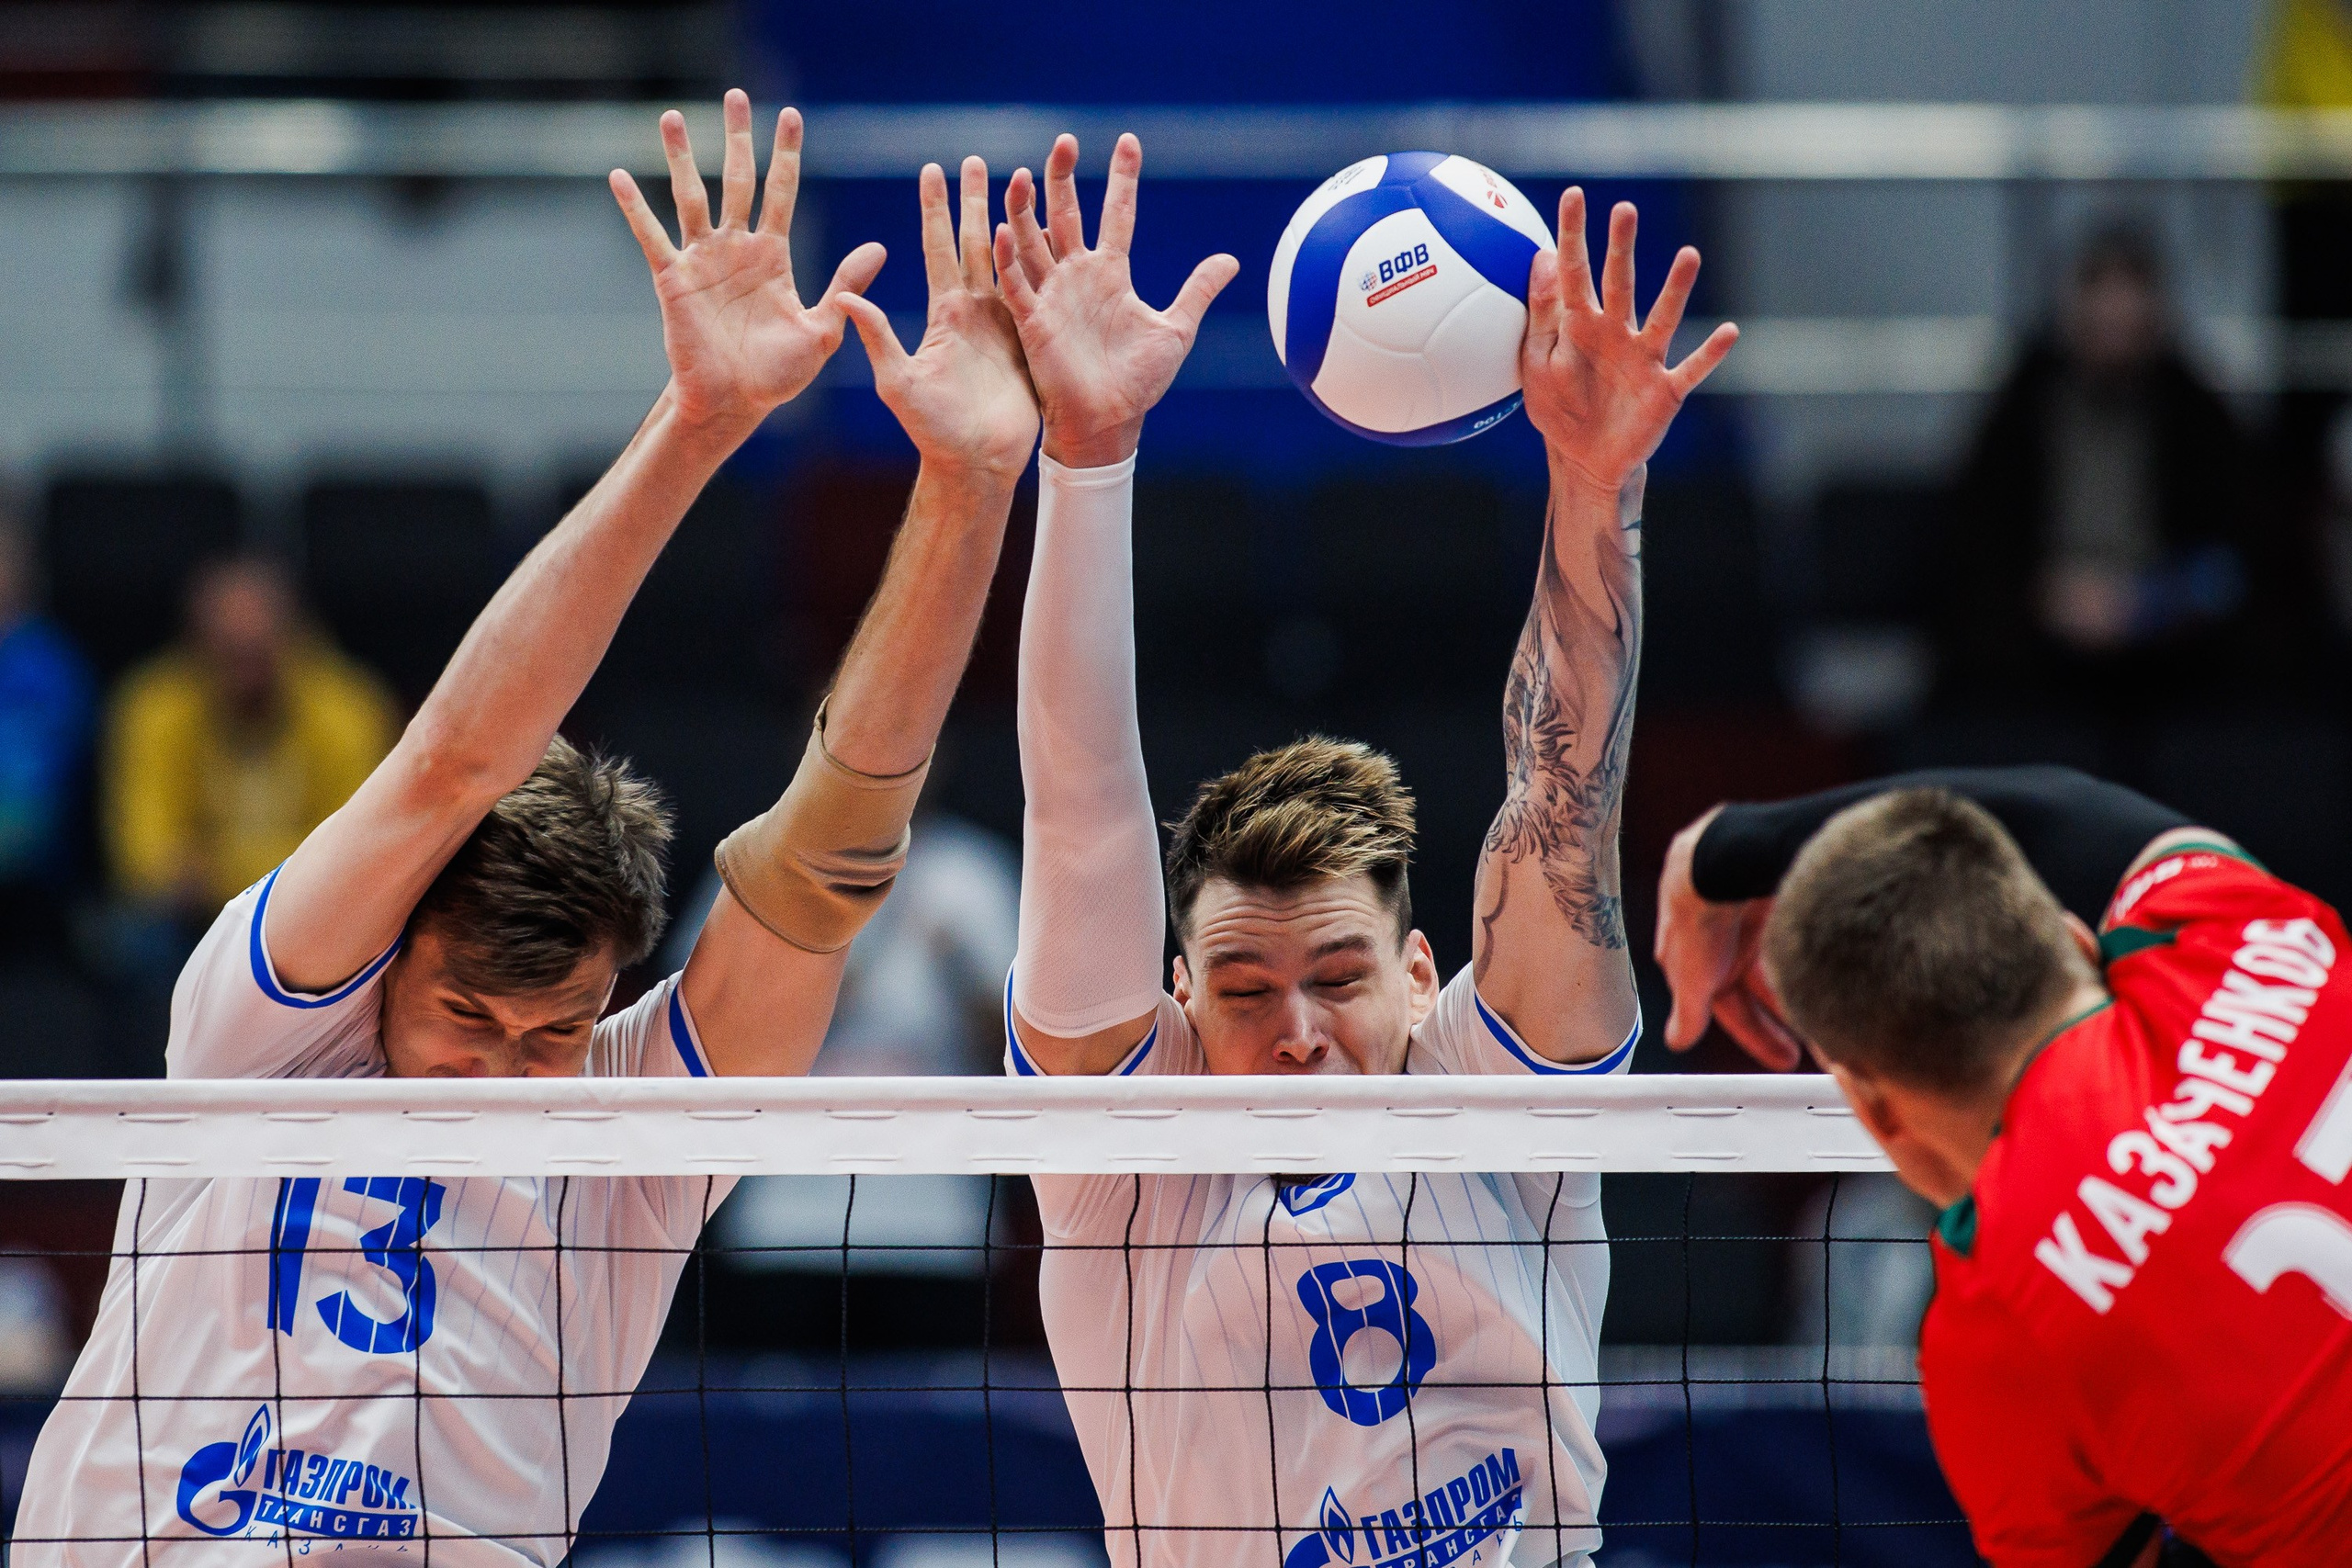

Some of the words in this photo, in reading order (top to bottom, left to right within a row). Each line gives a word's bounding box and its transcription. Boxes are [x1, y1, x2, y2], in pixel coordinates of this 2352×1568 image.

[1379, 243, 1430, 283] ВФВ
[266, 1178, 447, 1355] 13
[1296, 1258, 1437, 1427] 8
[260, 1500, 411, 1537] ТРАНСГАЗ
[1360, 1447, 1521, 1561] ГАЗПРОМ
